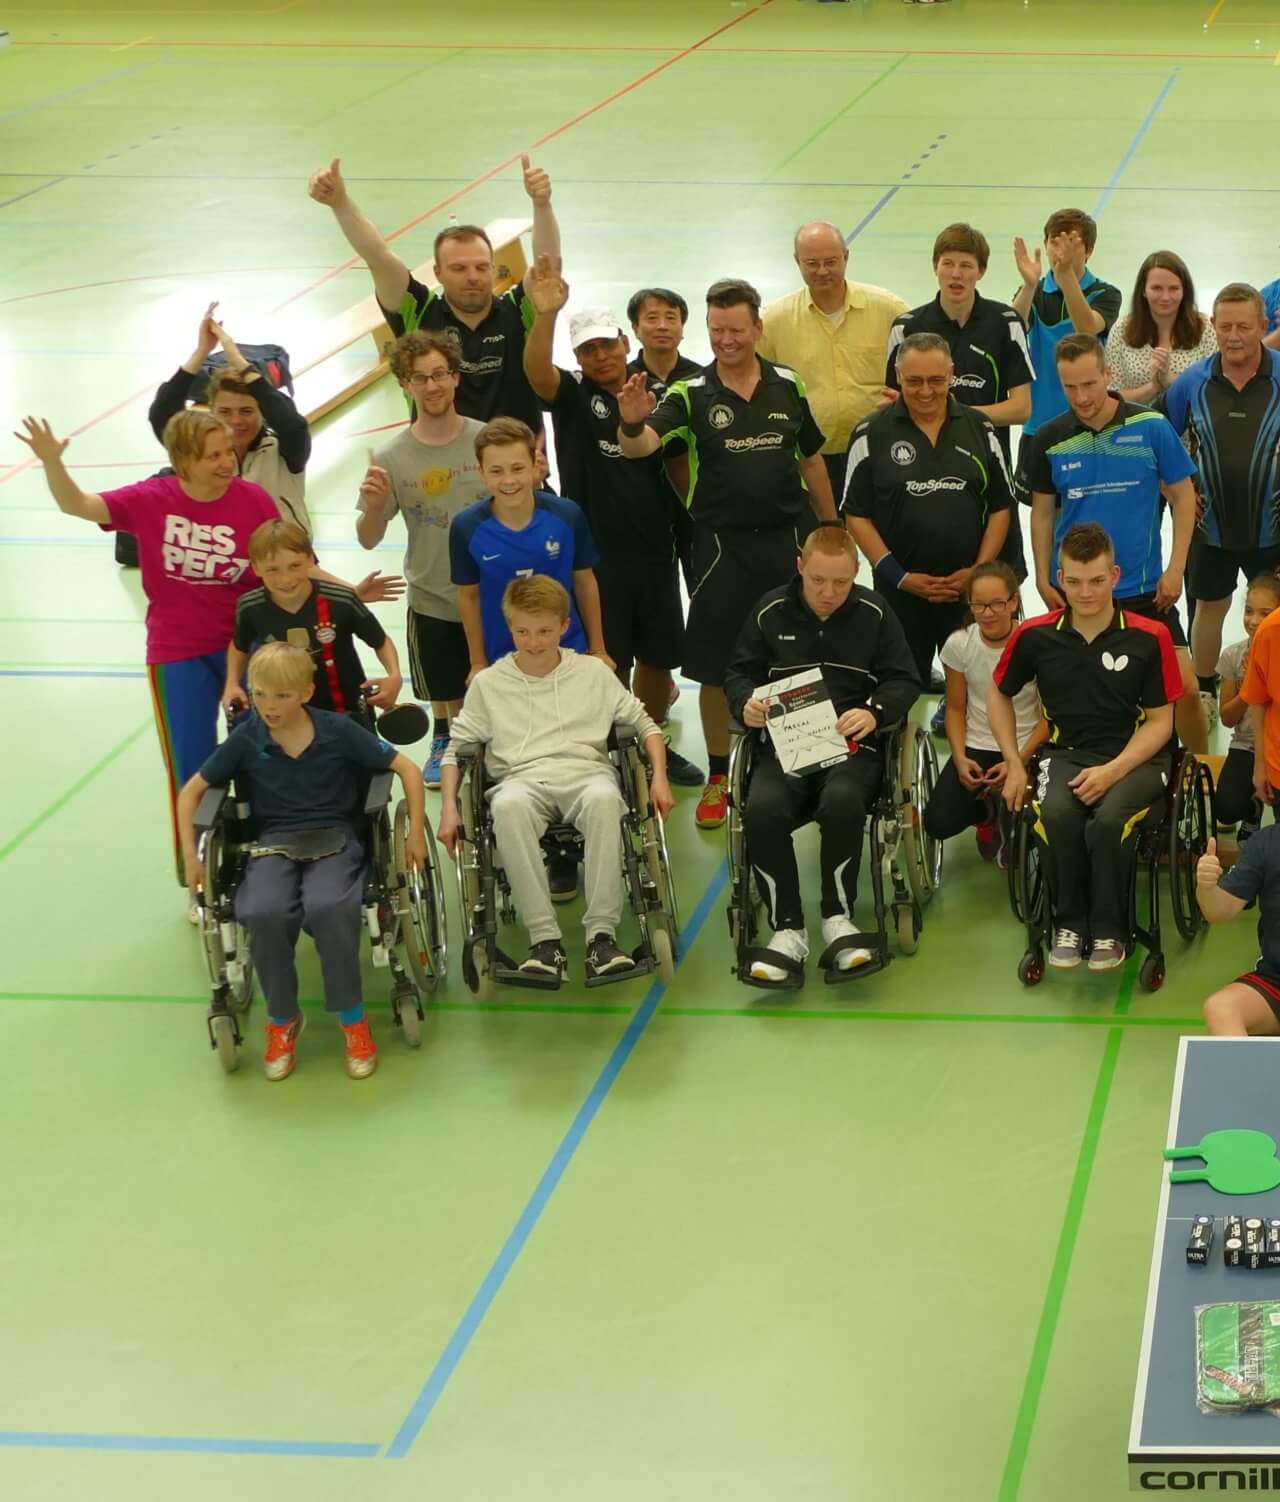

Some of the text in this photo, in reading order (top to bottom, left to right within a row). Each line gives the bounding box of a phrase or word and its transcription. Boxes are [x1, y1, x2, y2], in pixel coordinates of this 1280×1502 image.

[725, 434, 783, 450] TopSpeed
[905, 480, 967, 493] TopSpeed
[163, 513, 236, 556] RES
